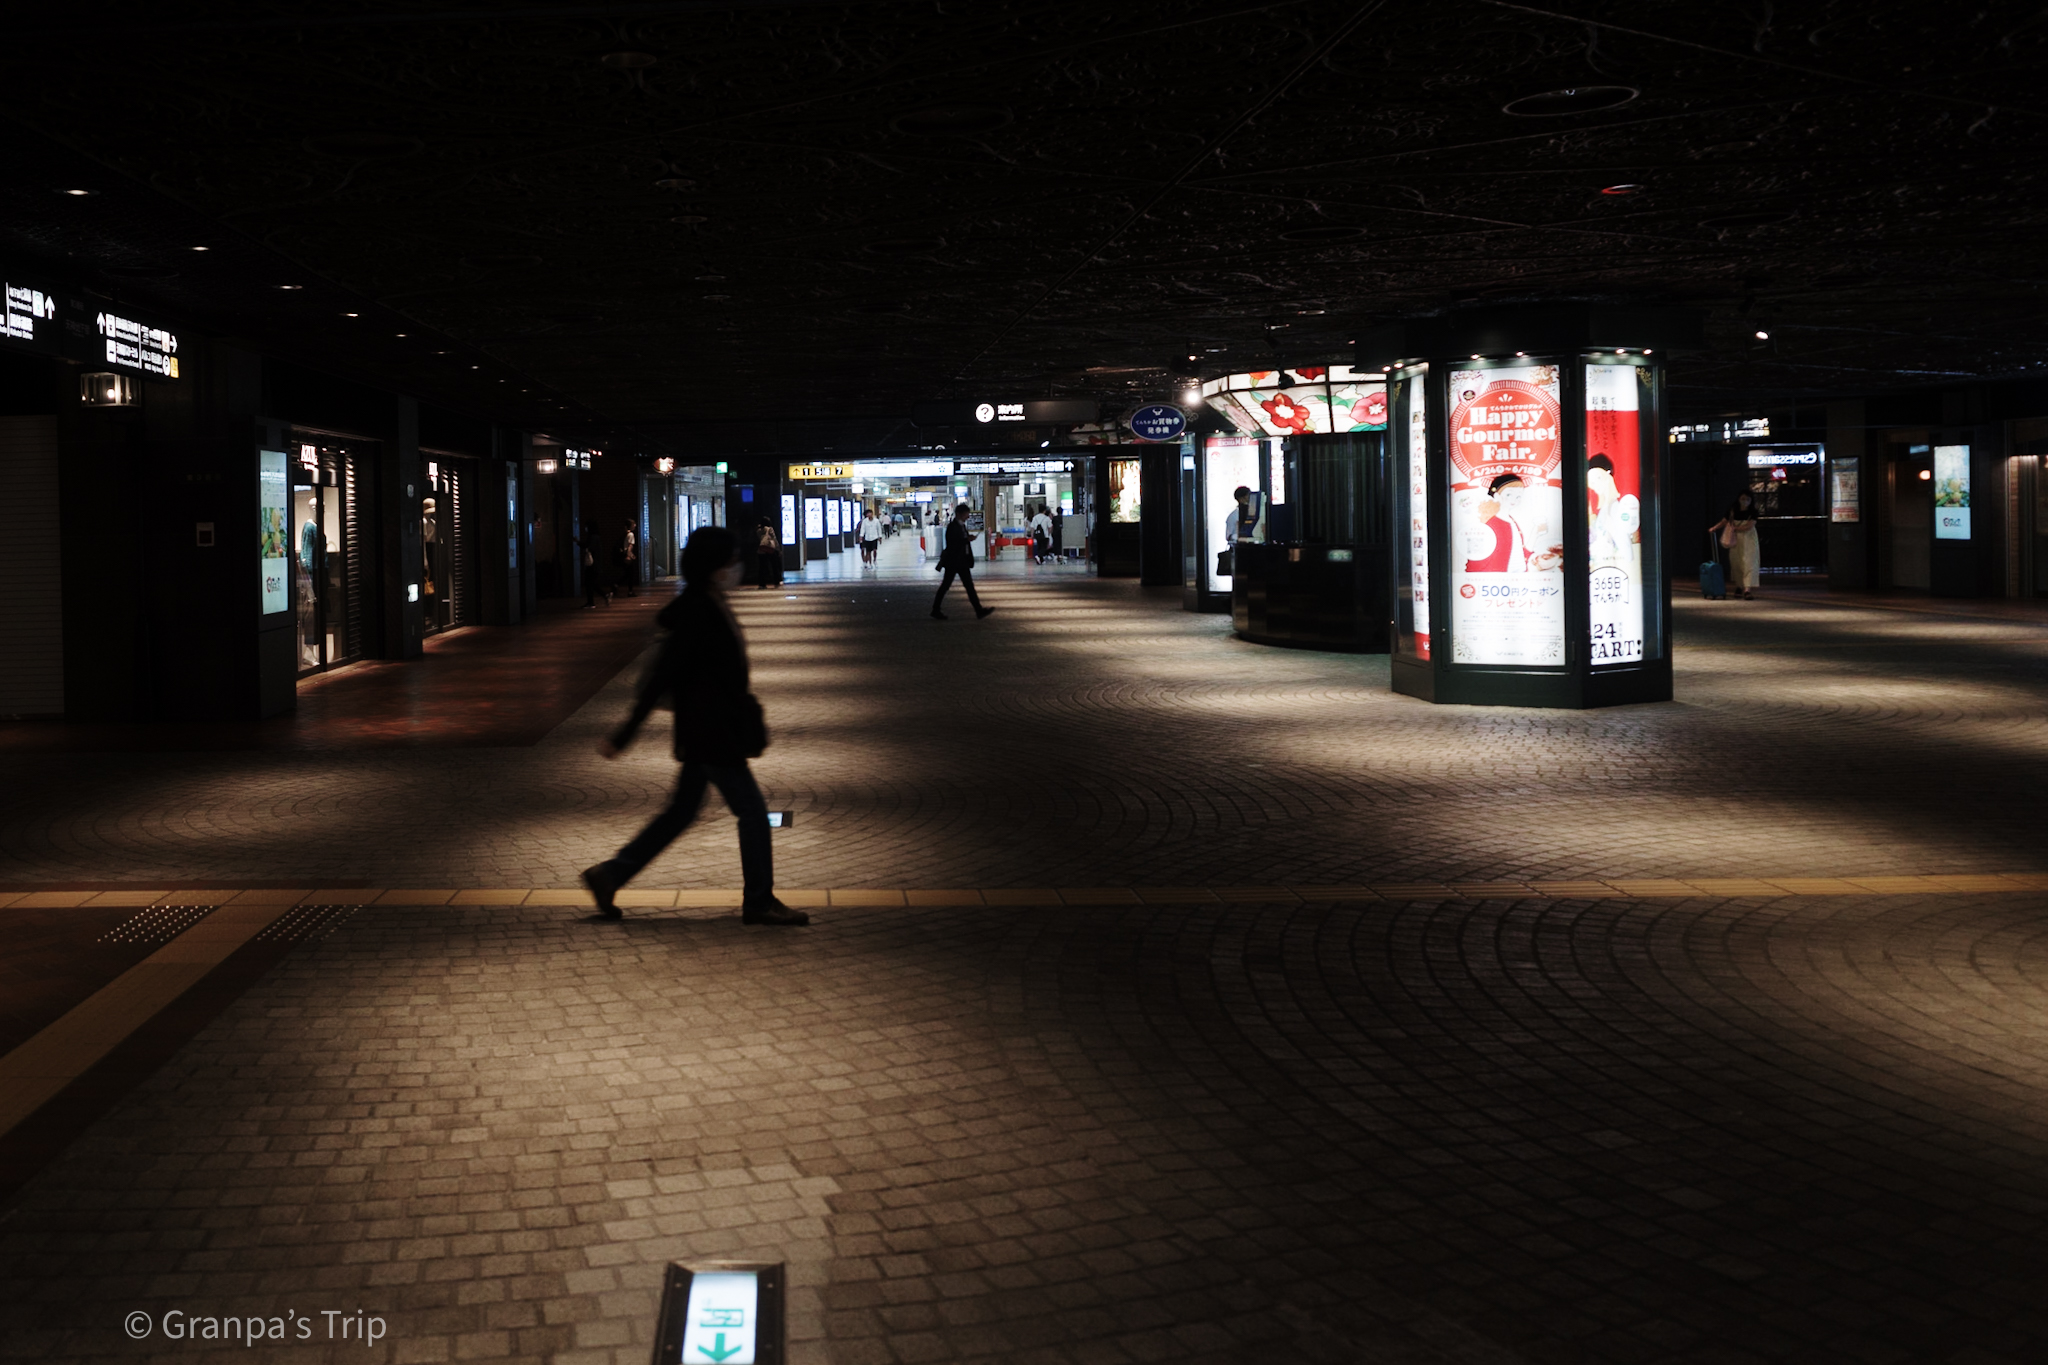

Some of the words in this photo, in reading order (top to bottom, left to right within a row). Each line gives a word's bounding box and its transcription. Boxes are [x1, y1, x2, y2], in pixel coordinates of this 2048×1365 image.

[997, 404, 1024, 415] 案内所
[1469, 406, 1544, 428] Happy
[1456, 424, 1557, 444] Gourmet
[1235, 437, 1251, 446] MAP
[1482, 442, 1537, 461] Fair.
[1594, 577, 1621, 590] 365日
[1481, 585, 1560, 597] 500円クーポン
[1593, 592, 1622, 603] てんちか
[1594, 622, 1617, 639] 24
